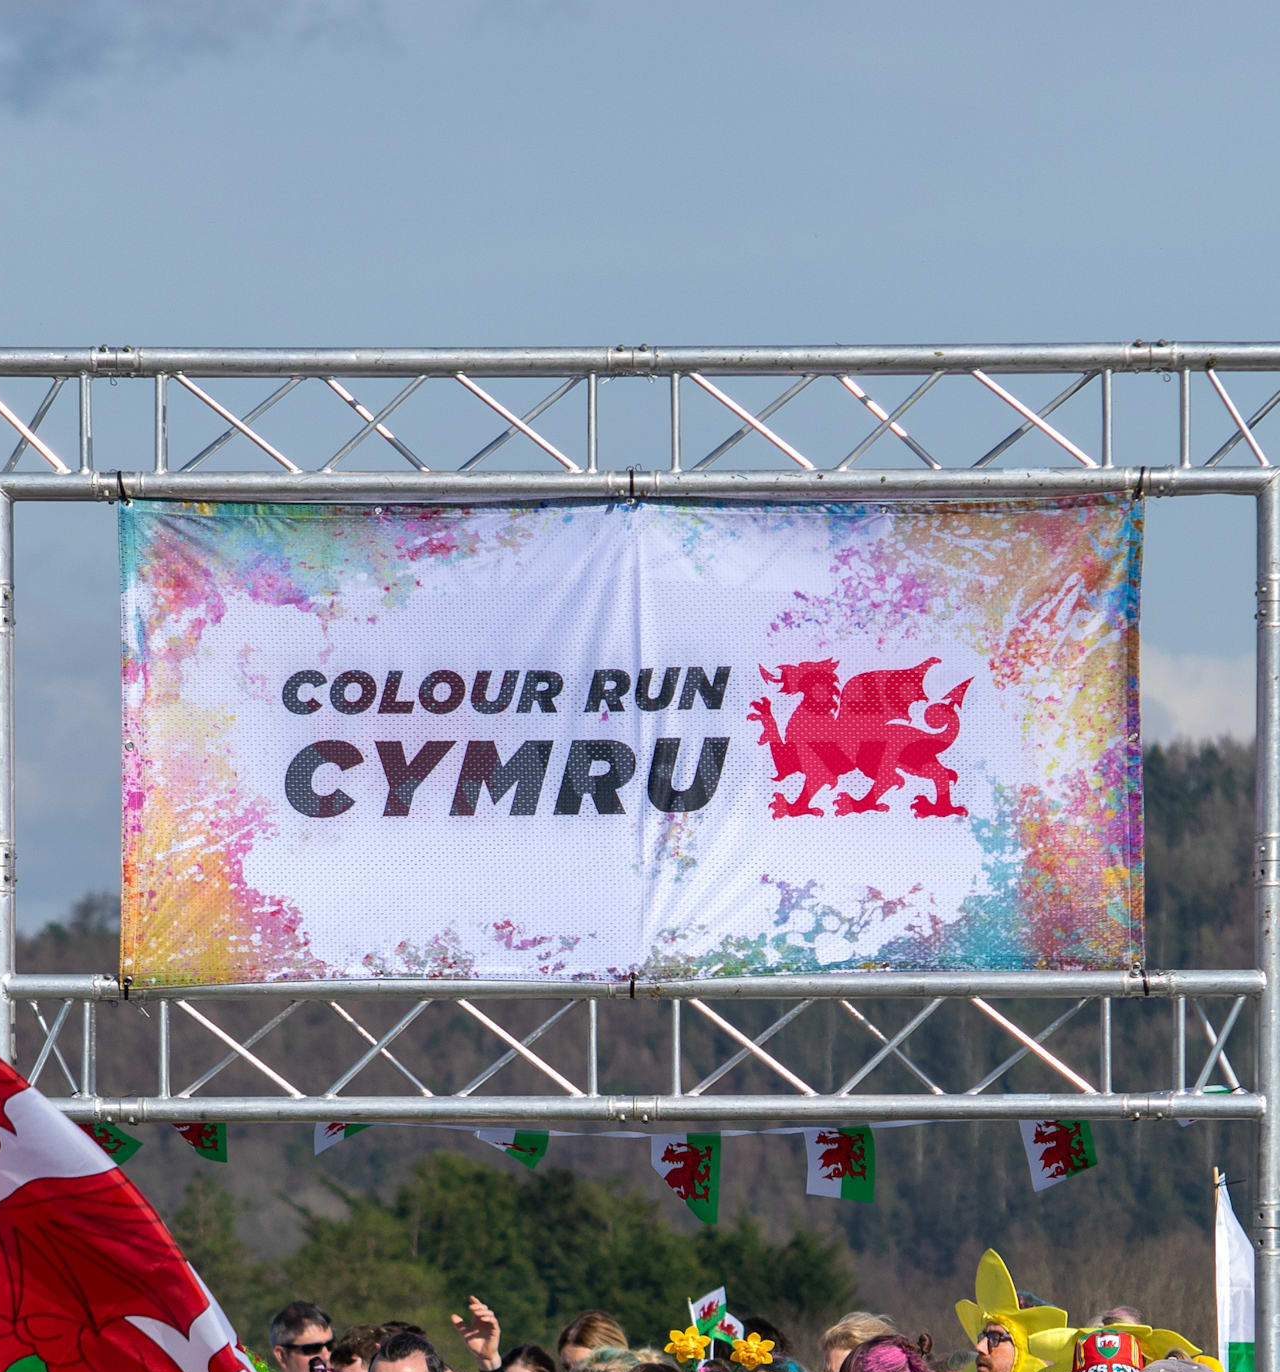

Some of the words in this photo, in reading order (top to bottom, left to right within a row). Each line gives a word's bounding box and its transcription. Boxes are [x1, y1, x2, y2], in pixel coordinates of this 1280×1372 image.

[281, 668, 564, 716] COLOUR
[583, 665, 732, 713] RUN
[284, 736, 731, 819] CYMRU
